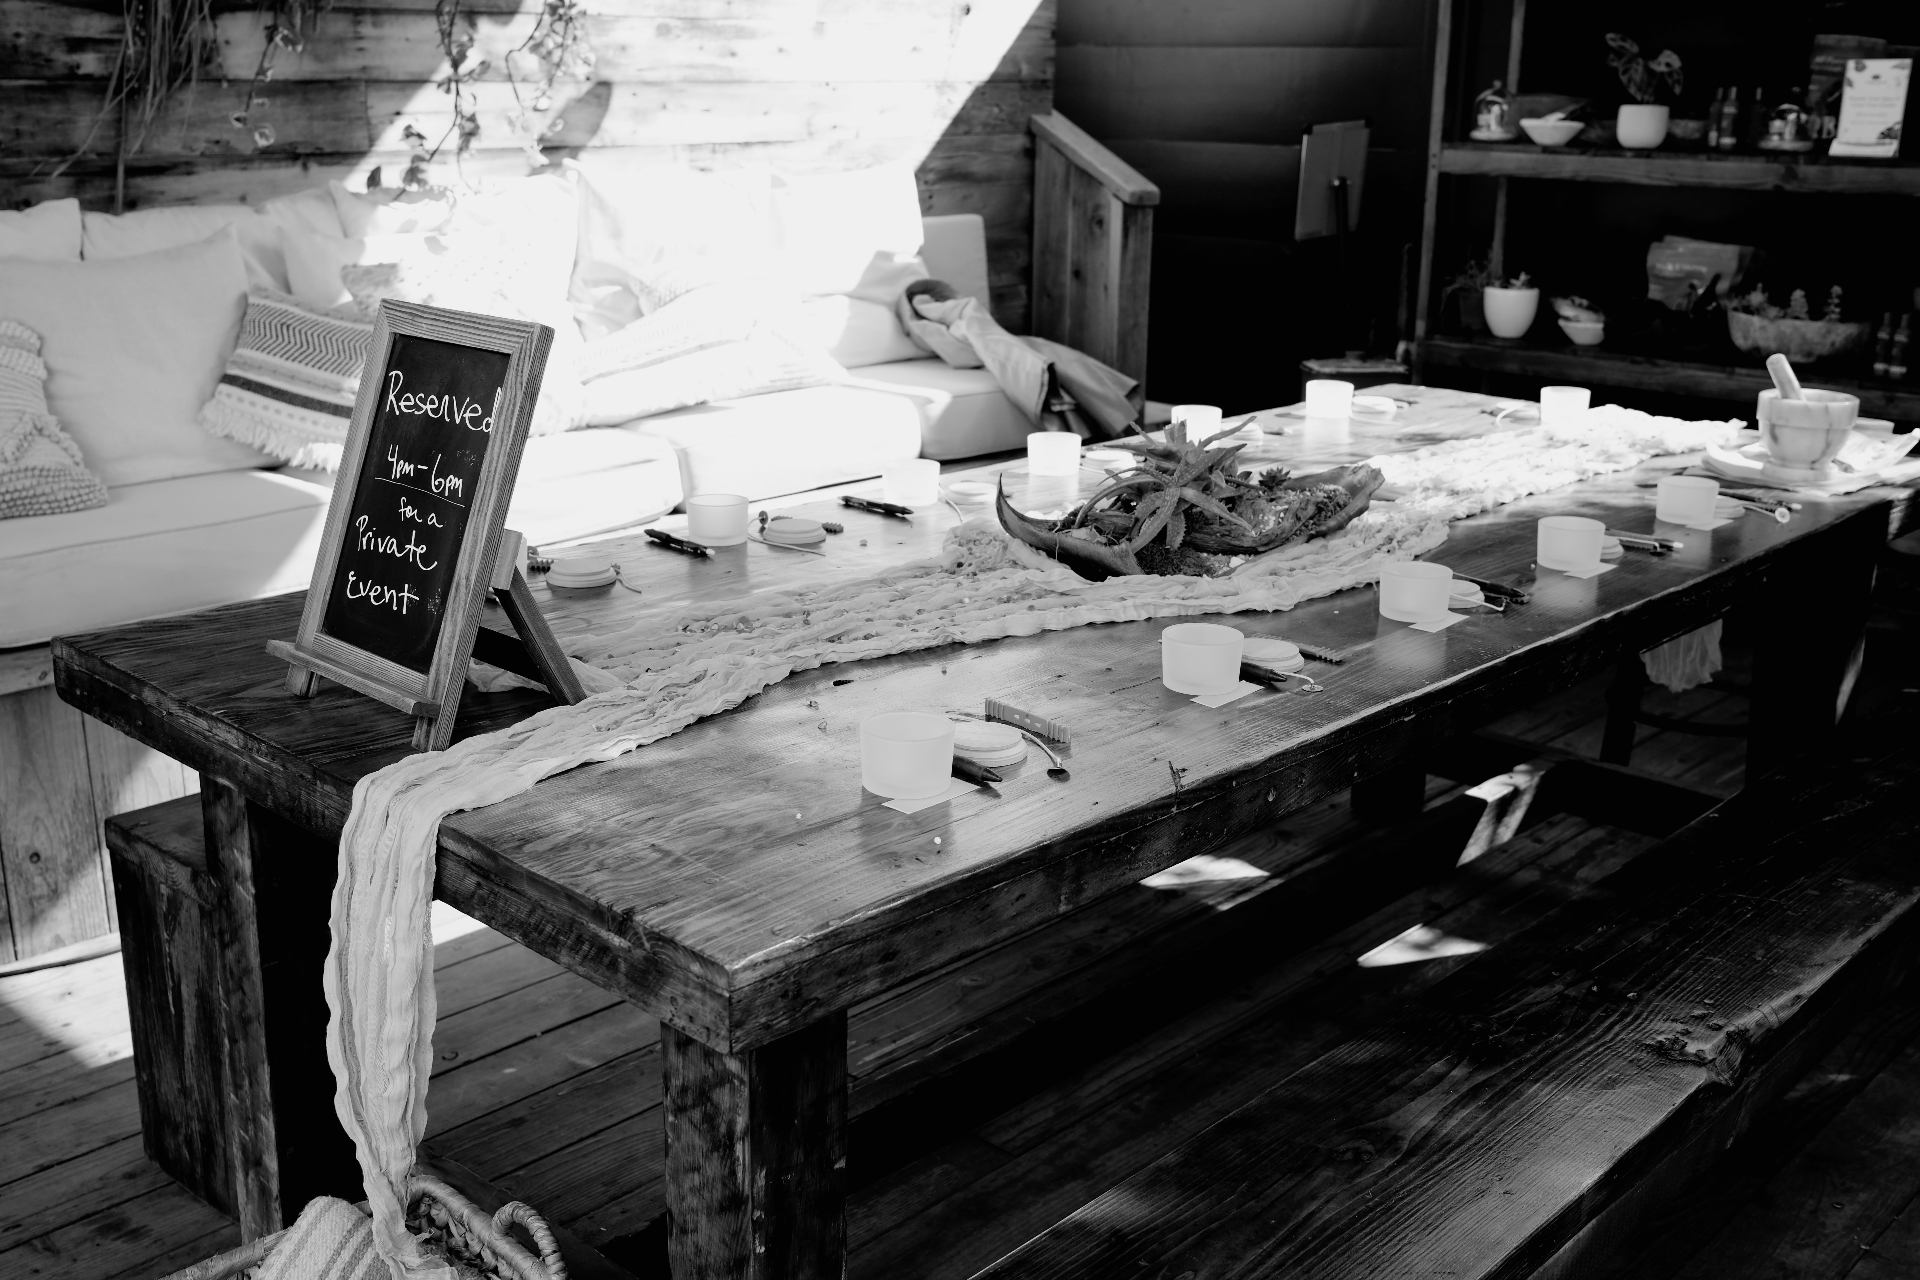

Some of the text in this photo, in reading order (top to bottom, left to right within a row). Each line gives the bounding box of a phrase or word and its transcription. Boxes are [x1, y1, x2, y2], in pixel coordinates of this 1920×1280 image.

[386, 370, 503, 433] Reserved
[399, 497, 444, 528] for a
[355, 515, 438, 571] Private
[346, 571, 420, 615] Event
